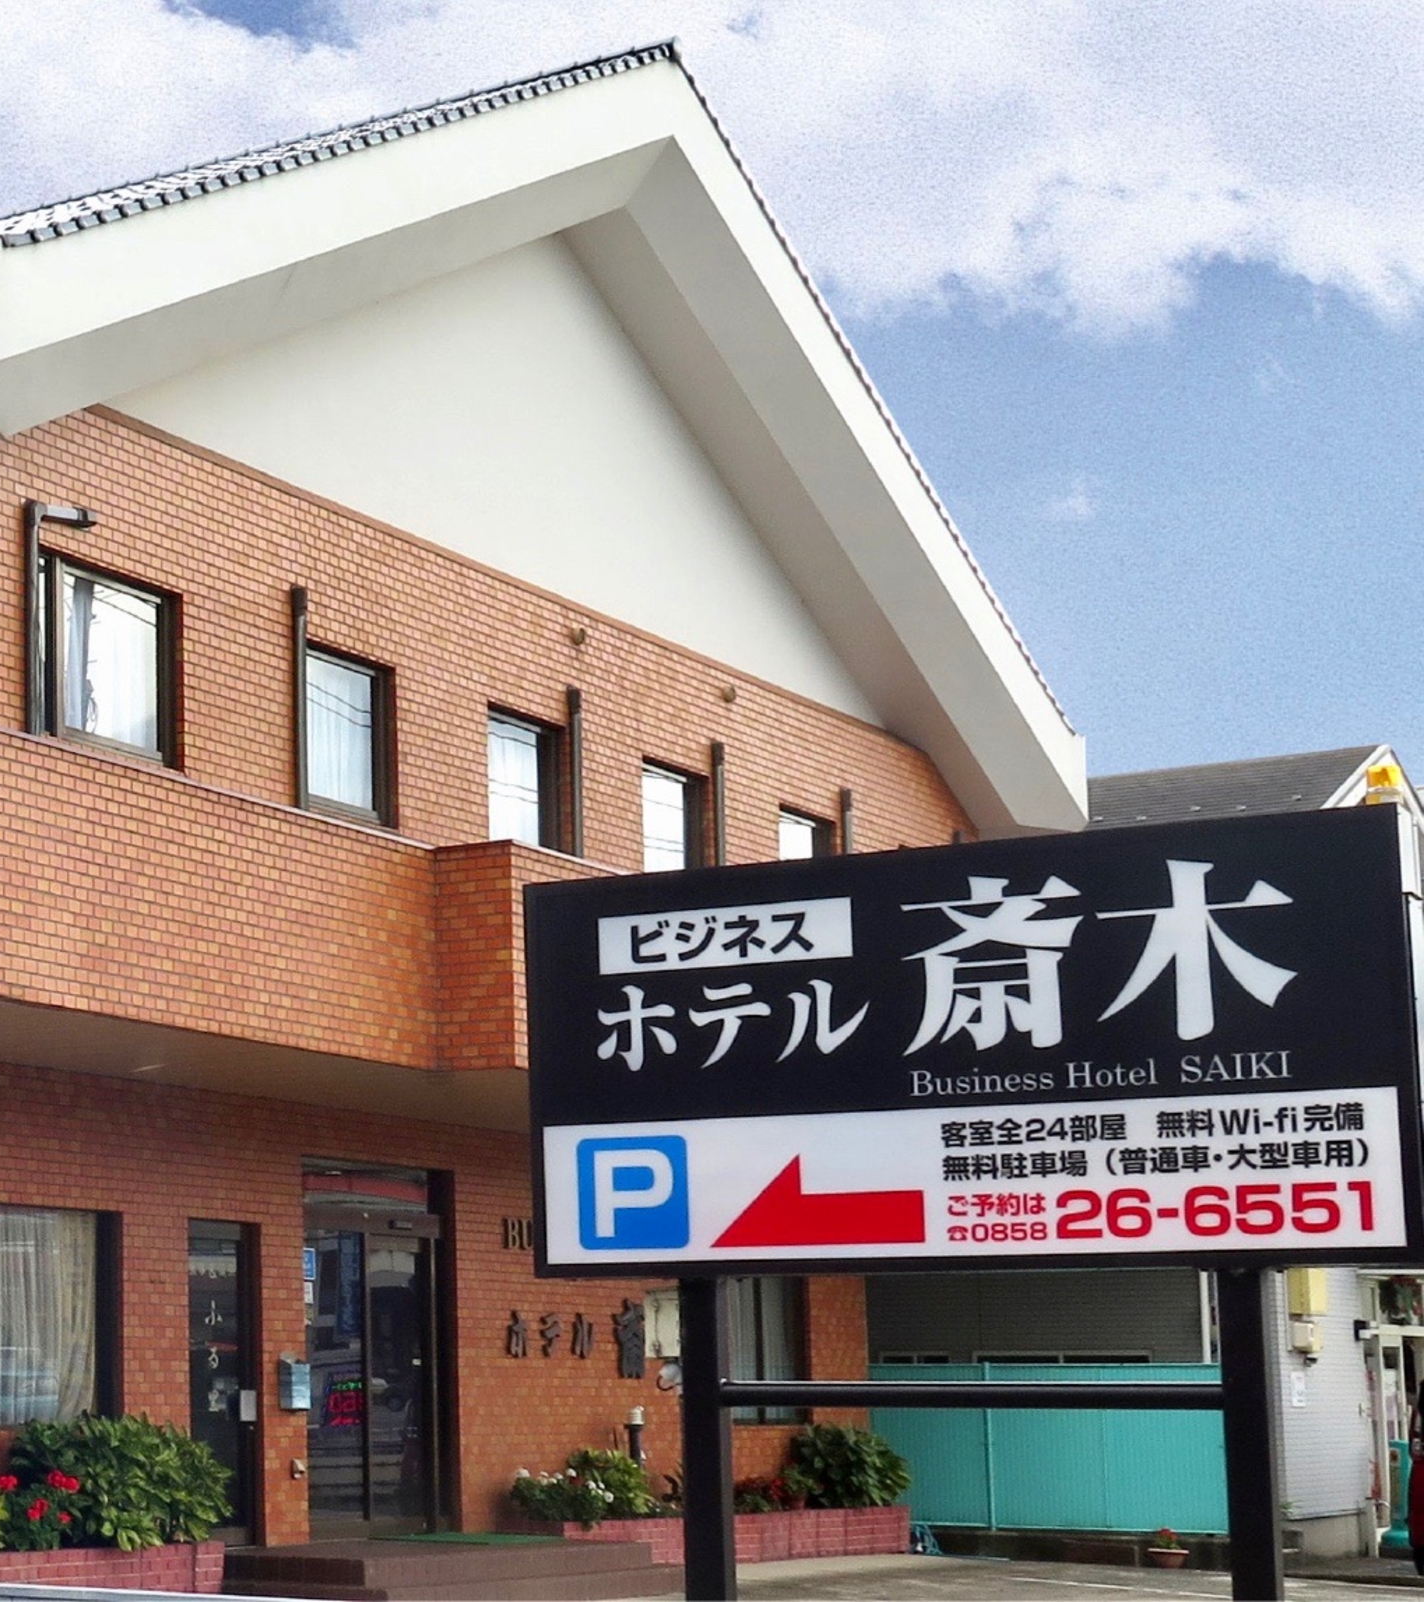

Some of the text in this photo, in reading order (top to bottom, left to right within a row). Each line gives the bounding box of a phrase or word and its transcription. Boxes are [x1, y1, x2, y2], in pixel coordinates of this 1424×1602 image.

[630, 912, 814, 963] ビジネス
[901, 859, 1298, 1057] 斎木
[597, 979, 870, 1072] ホテル
[909, 1050, 1293, 1098] Business Hotel SAIKI
[941, 1102, 1365, 1148] 客室全24部屋 無料Wi-fi完備
[594, 1149, 674, 1238] P
[947, 1192, 1047, 1218] ご予約は
[1054, 1179, 1377, 1242] 26-6551
